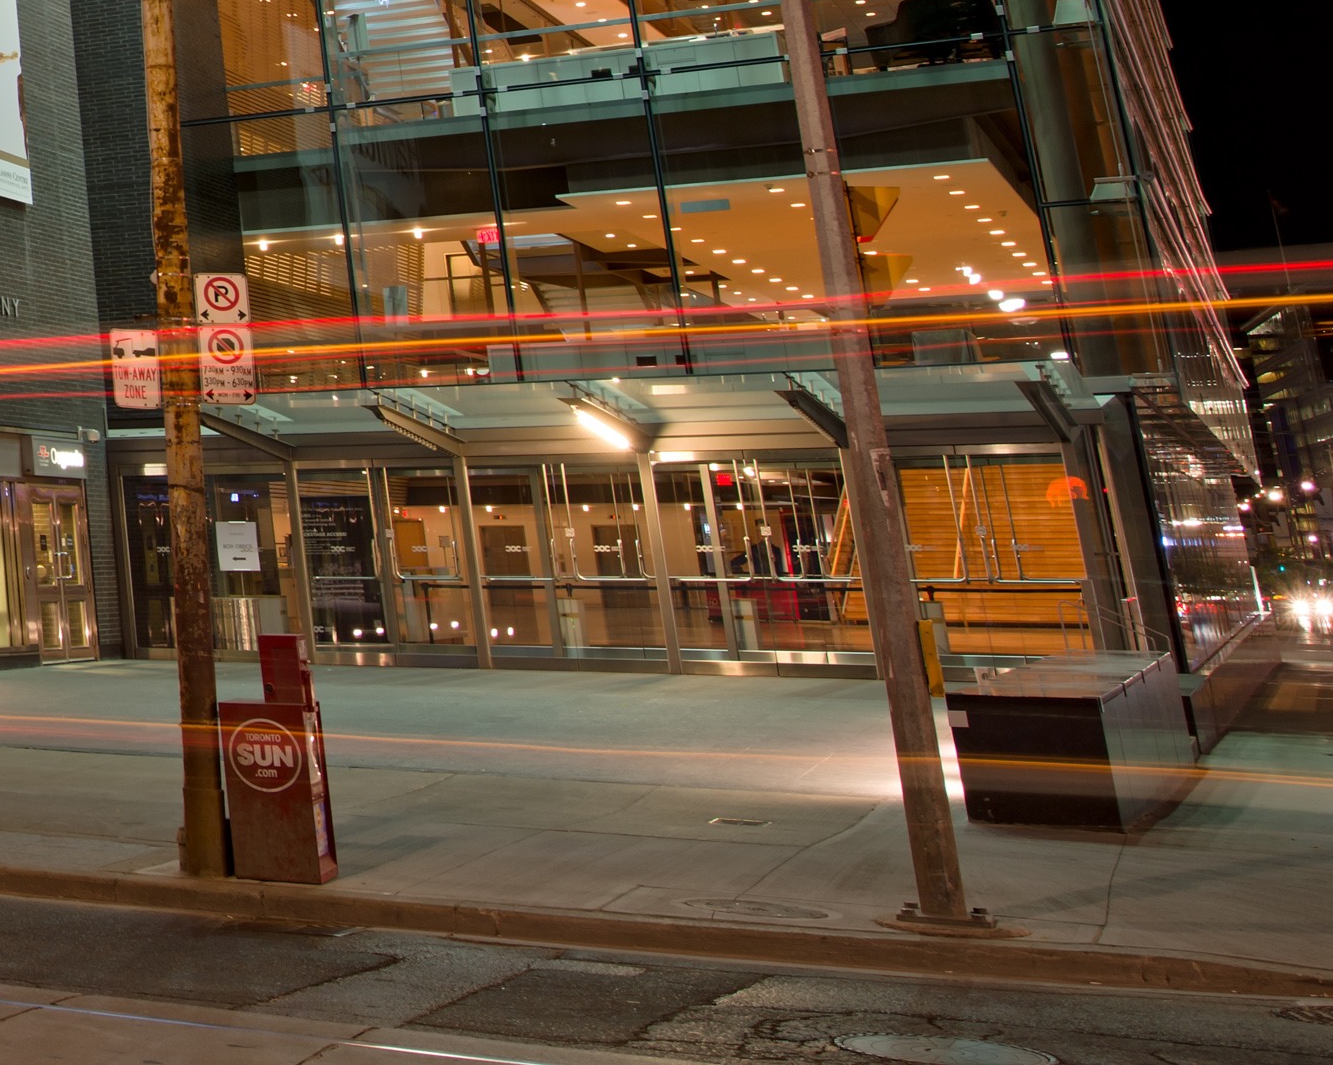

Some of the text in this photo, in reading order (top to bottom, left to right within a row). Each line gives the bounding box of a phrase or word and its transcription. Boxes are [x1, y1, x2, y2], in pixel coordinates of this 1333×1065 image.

[114, 365, 156, 381] TOW-AWAY
[124, 384, 147, 399] ZONE
[245, 733, 281, 743] TORONTO
[237, 743, 294, 767] SUN
[255, 768, 278, 777] .com
